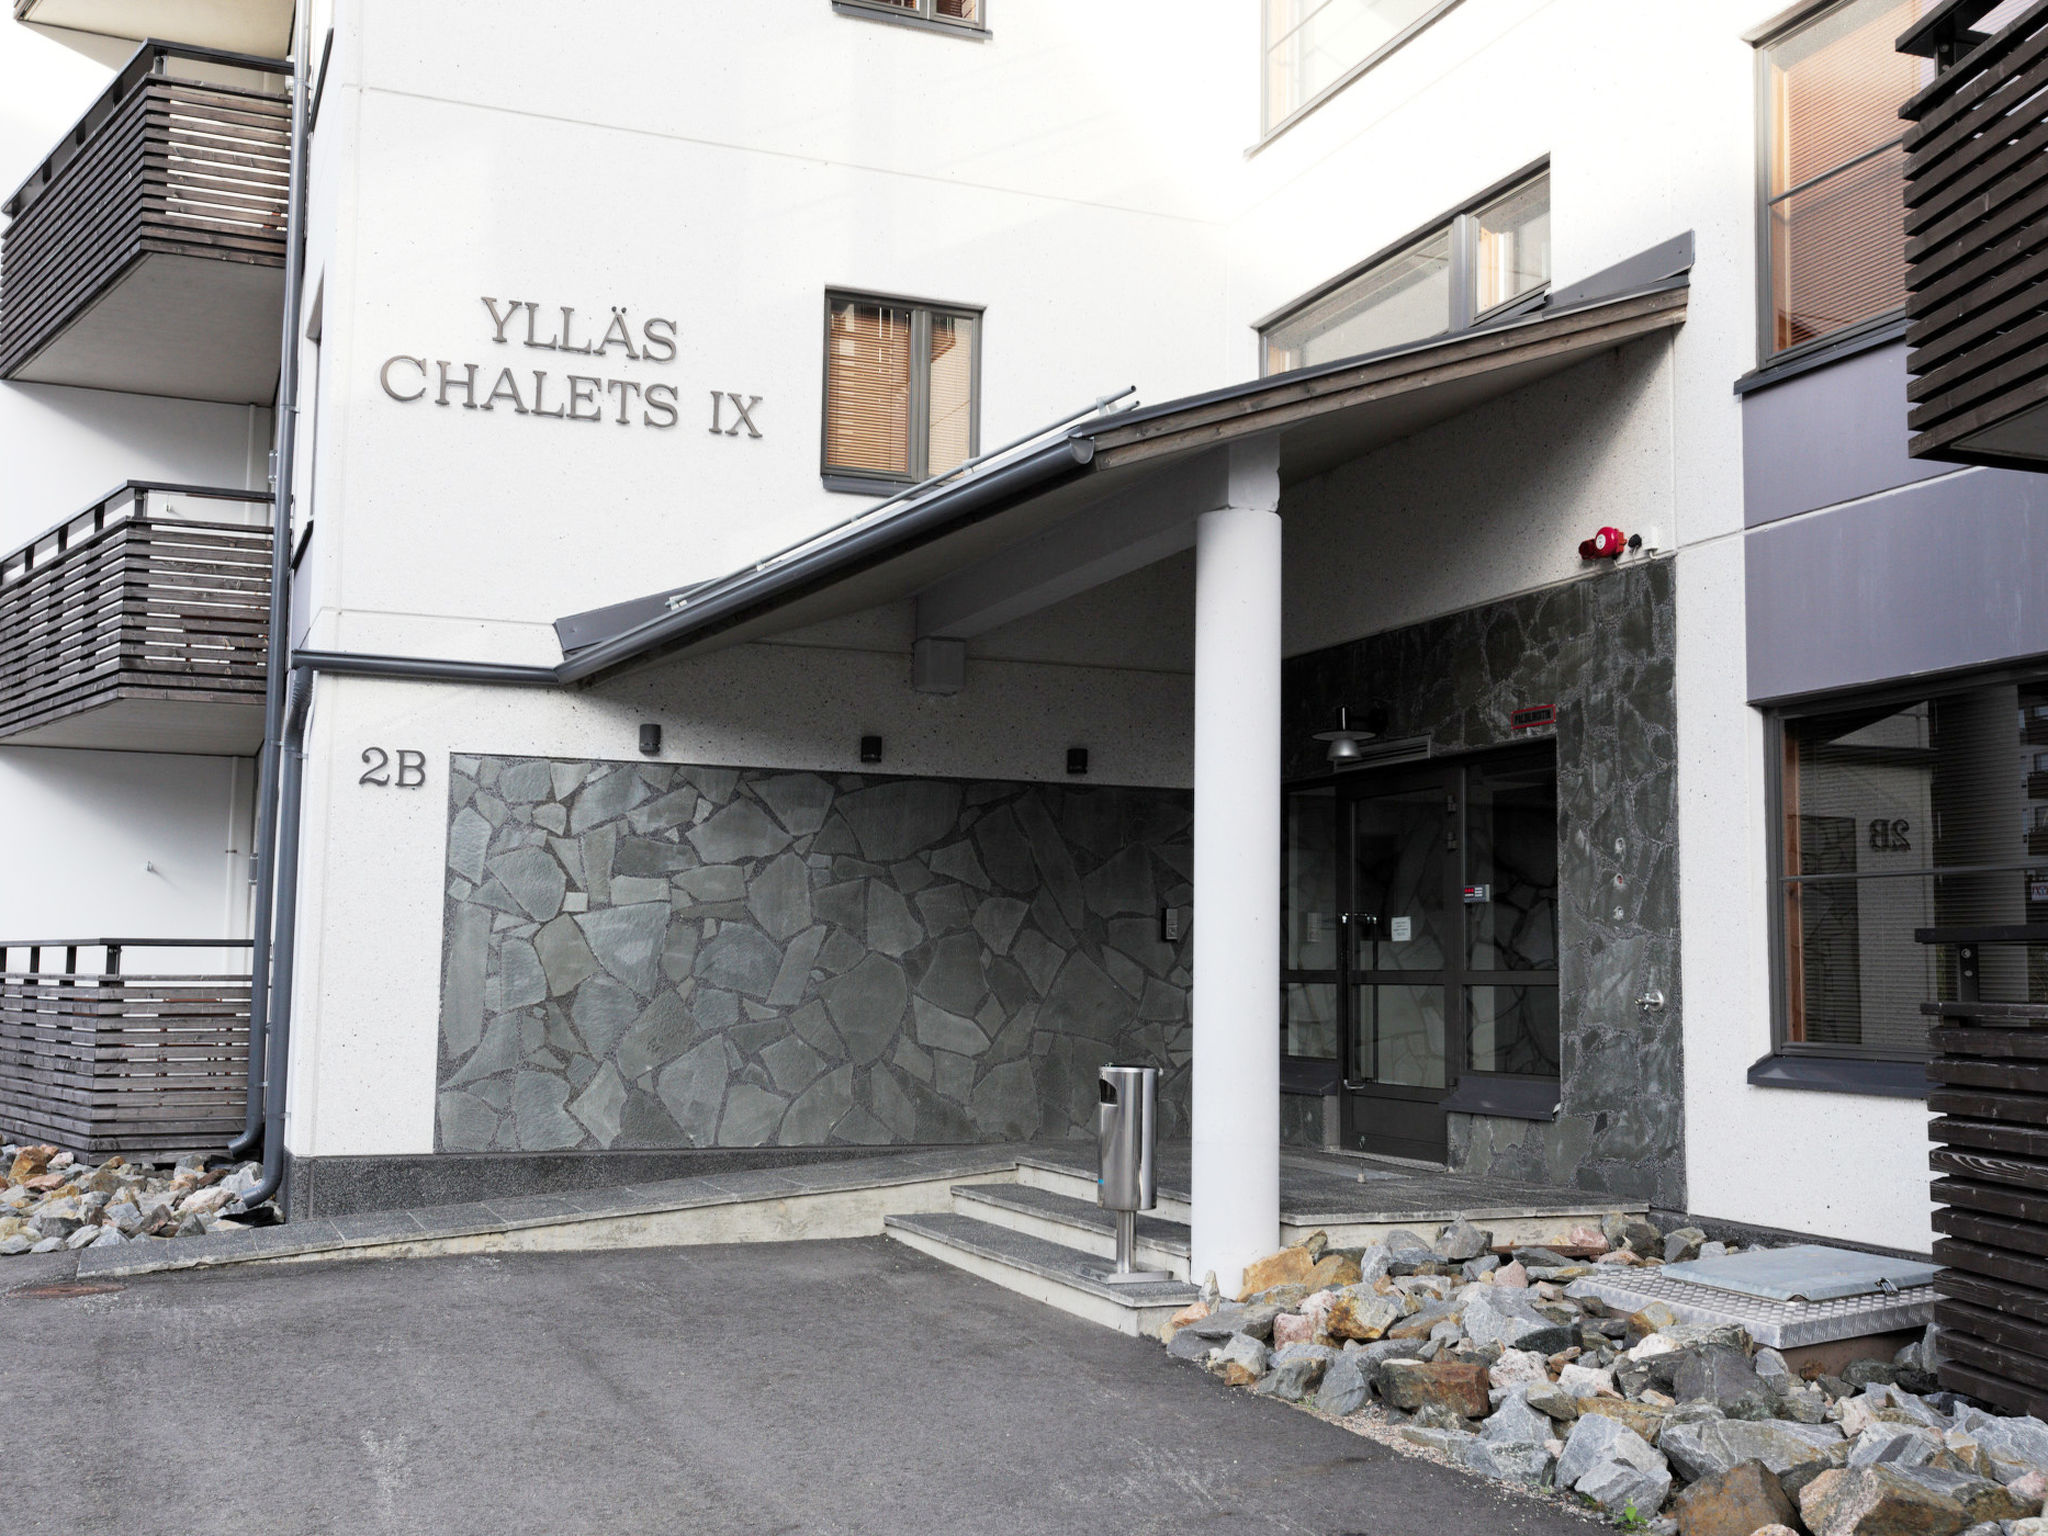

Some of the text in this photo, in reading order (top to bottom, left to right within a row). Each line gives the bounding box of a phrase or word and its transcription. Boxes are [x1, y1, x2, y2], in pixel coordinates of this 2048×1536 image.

[481, 297, 677, 363] YLLÄS
[380, 355, 763, 440] CHALETS IX
[358, 746, 426, 788] 2B
